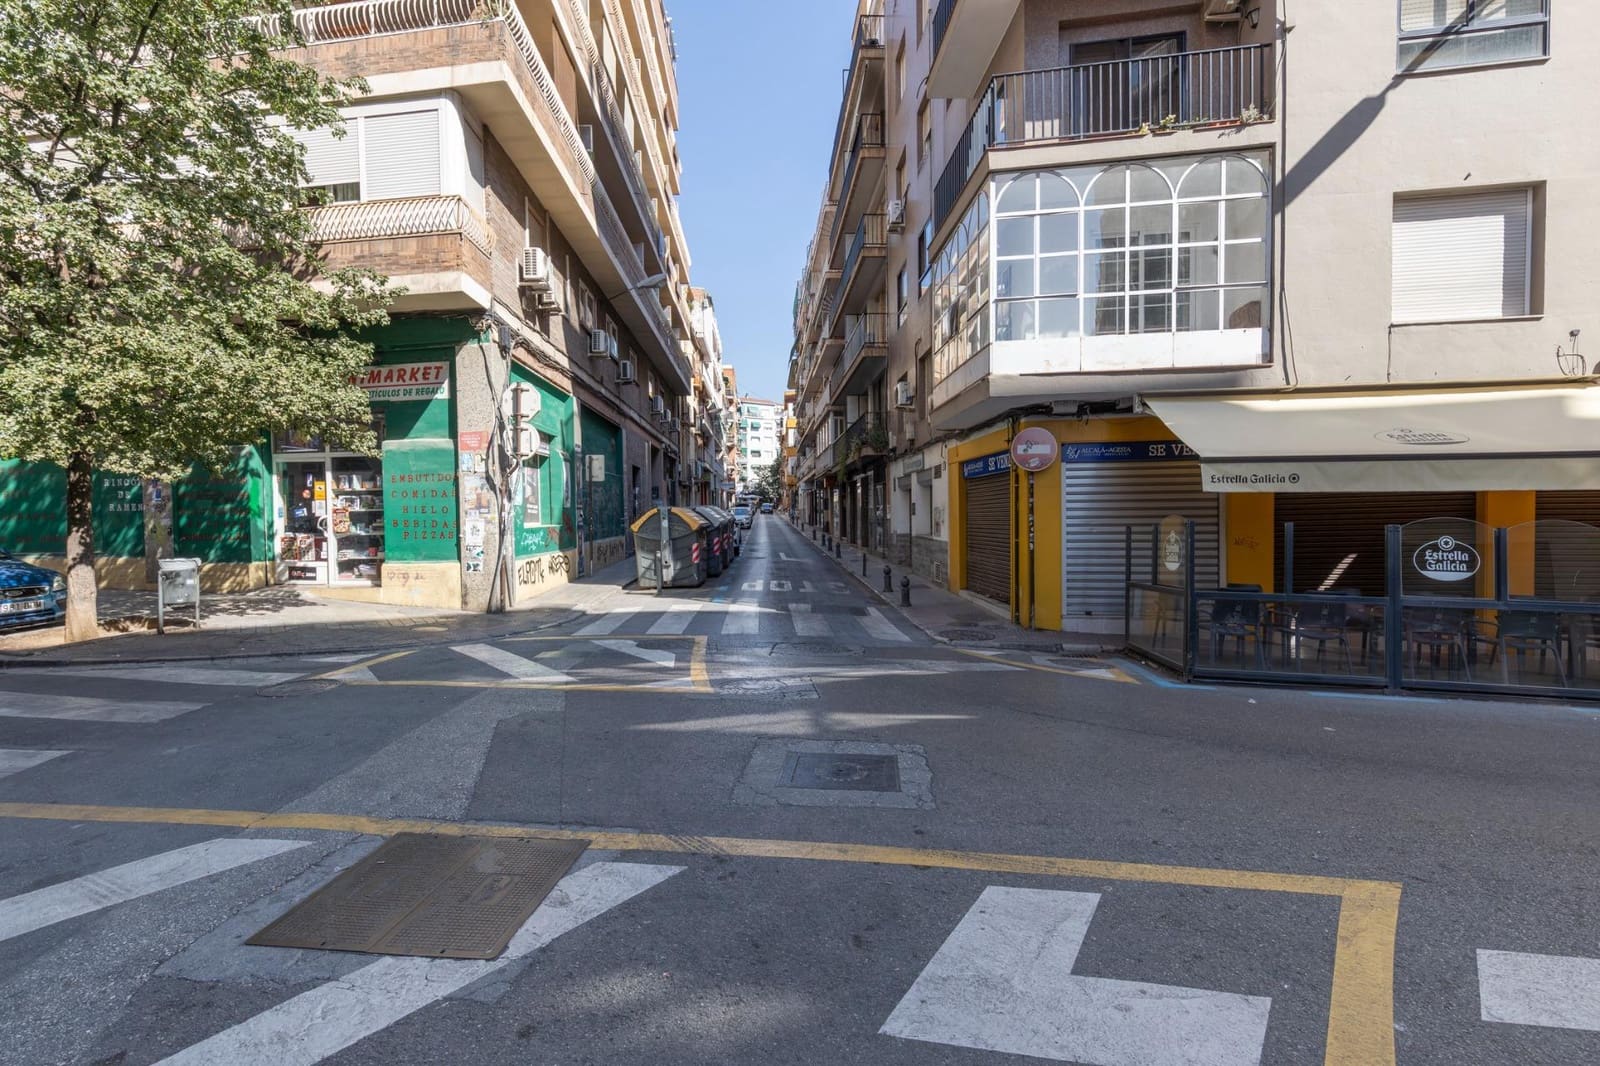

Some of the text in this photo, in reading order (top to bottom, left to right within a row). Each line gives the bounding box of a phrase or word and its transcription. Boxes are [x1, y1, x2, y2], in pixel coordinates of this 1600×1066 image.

[403, 388, 413, 396] DE
[416, 387, 445, 395] REGALO
[1149, 444, 1166, 456] SE
[1171, 443, 1196, 456] VE
[989, 457, 996, 471] SE
[1210, 474, 1286, 484] Estrella Galicia
[109, 503, 145, 512] RAMEN
[403, 505, 449, 514] HIELO
[403, 530, 454, 540] PIZZAS
[1425, 550, 1469, 561] Estrella
[1426, 560, 1467, 571] Galicia
